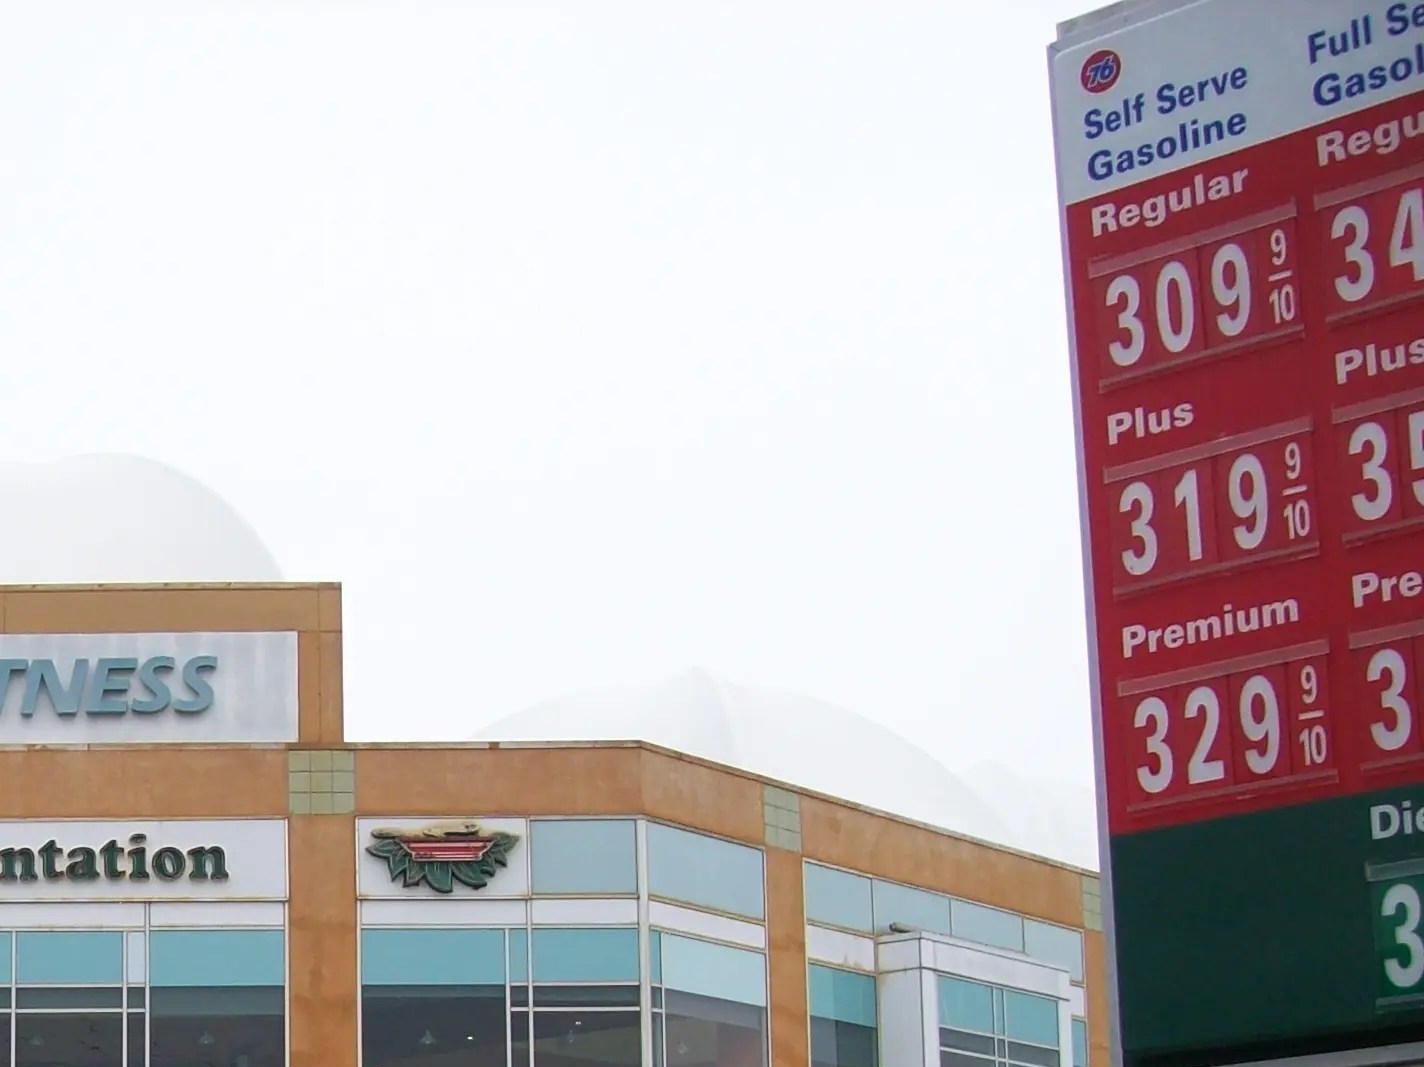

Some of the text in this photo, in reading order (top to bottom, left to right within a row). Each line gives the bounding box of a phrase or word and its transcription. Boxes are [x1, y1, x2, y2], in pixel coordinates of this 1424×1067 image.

[1086, 54, 1116, 89] 76
[1308, 14, 1371, 64] Full
[1084, 66, 1248, 139] Self Serve
[1087, 112, 1247, 181] Gasoline
[1091, 168, 1249, 237] Regular
[1105, 243, 1252, 366] 309
[1107, 402, 1194, 445] Plus
[1119, 453, 1269, 576] 319
[1122, 598, 1299, 659] Premium
[1134, 674, 1281, 793] 329
